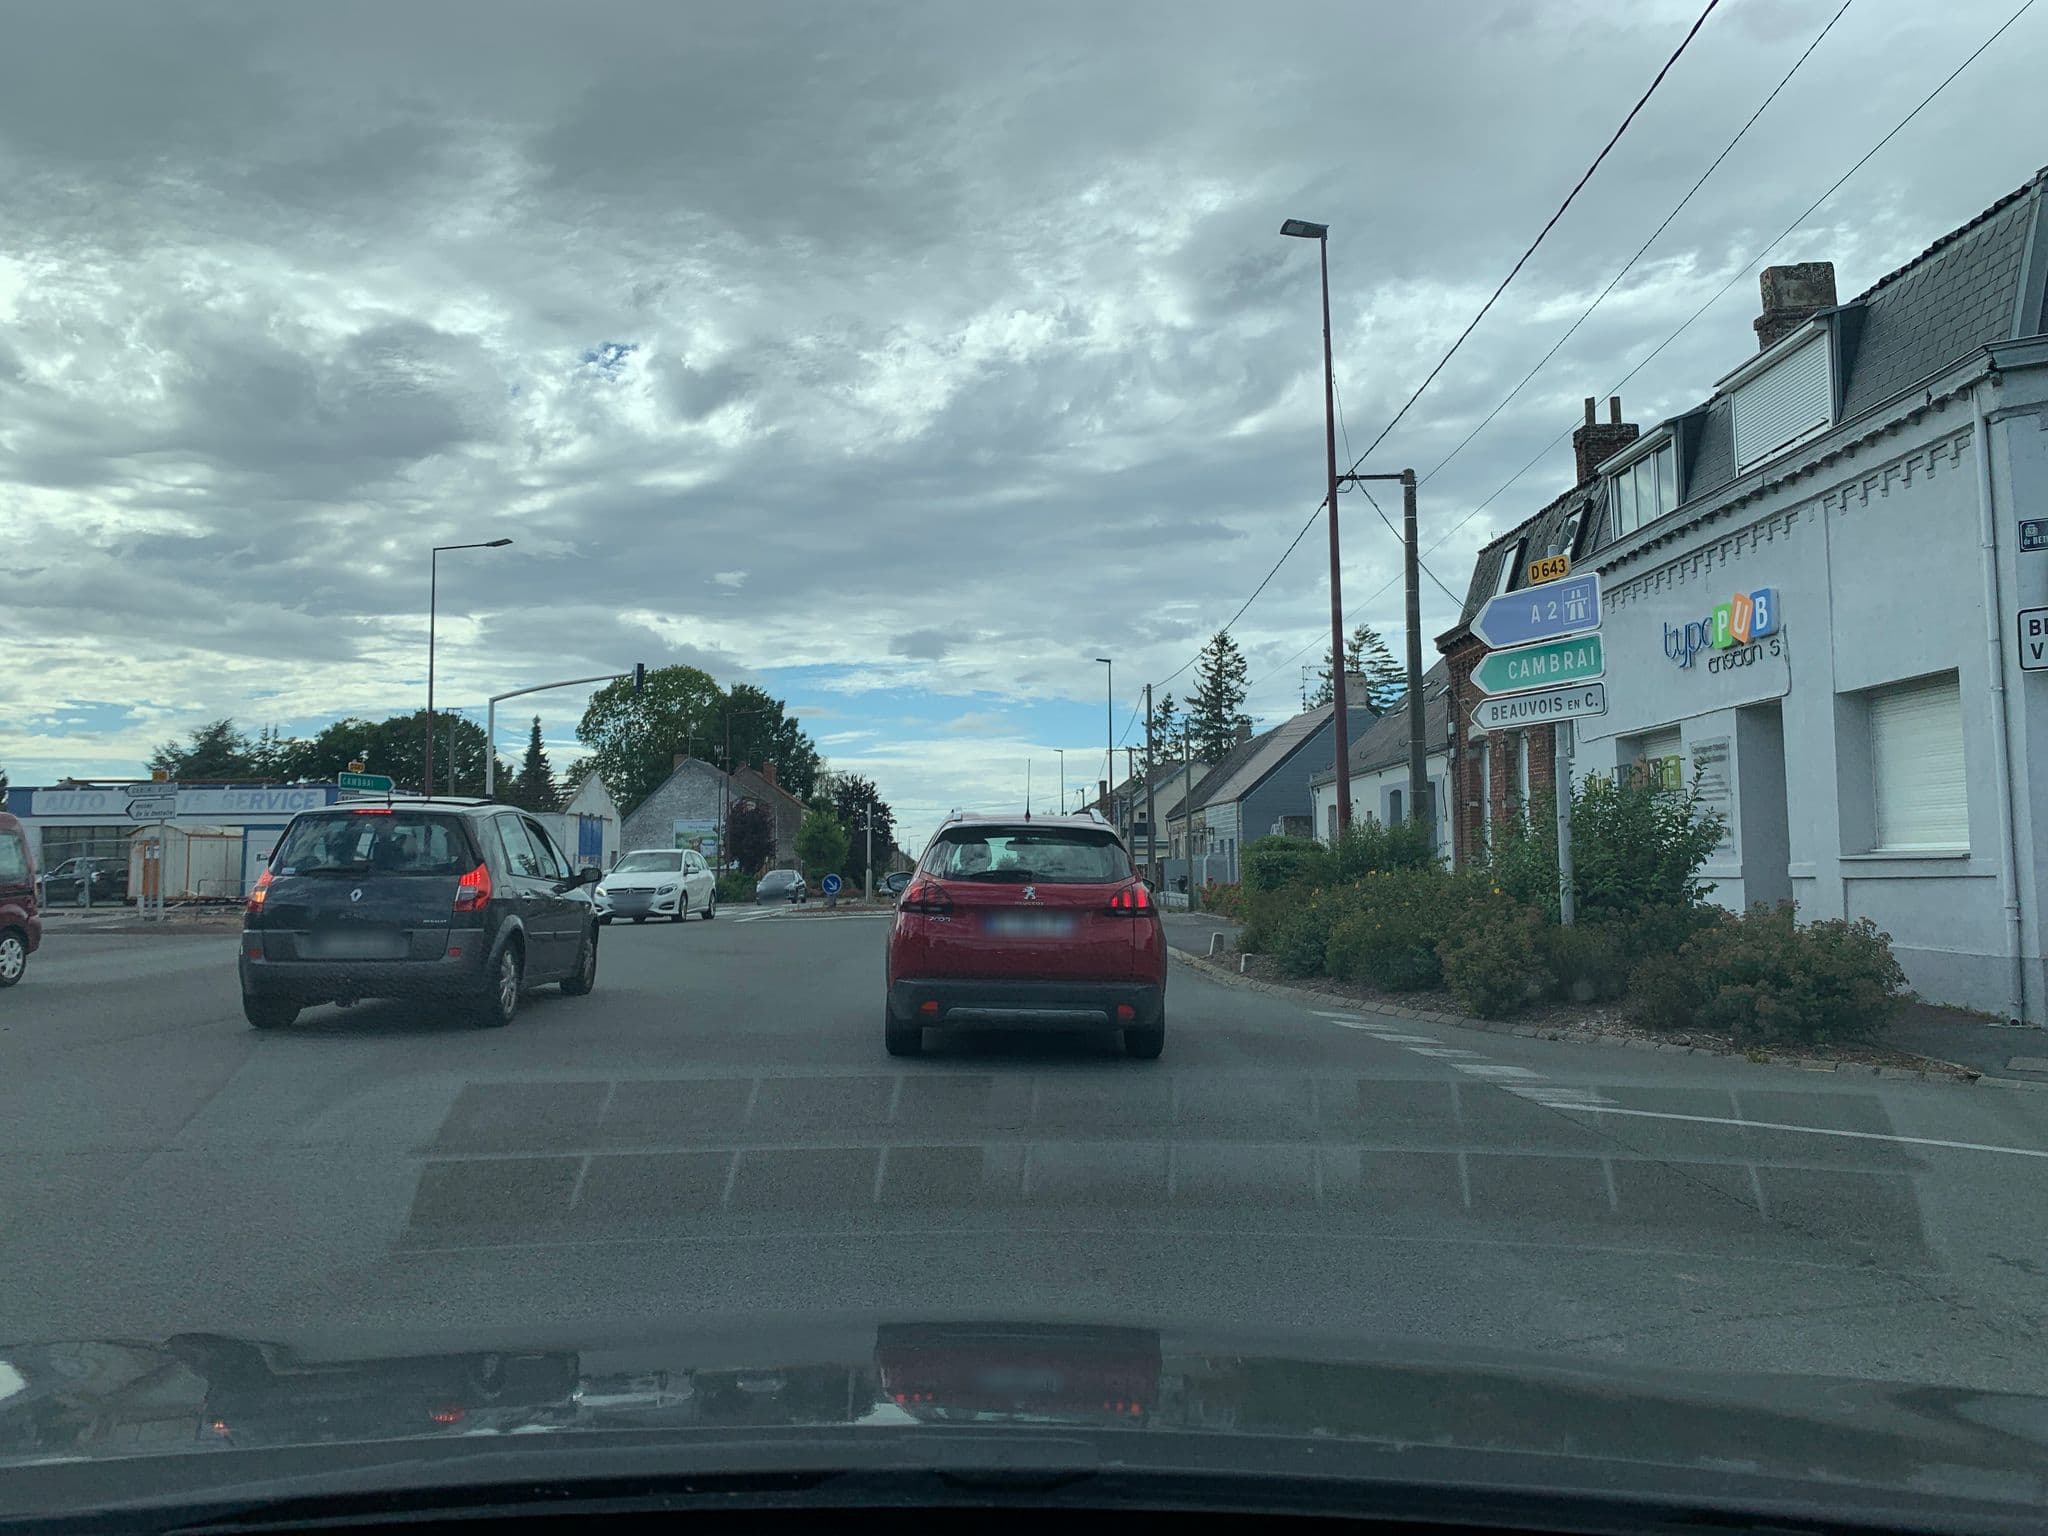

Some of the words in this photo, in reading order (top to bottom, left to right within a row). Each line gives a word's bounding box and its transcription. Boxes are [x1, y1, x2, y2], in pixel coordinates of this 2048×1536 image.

[1542, 559, 1567, 578] 643
[1531, 604, 1541, 625] A
[1547, 601, 1558, 620] 2
[1508, 646, 1596, 680] CAMBRAI
[1491, 697, 1563, 721] BEAUVOIS
[1567, 699, 1581, 711] EN
[1585, 692, 1599, 708] C.
[45, 792, 106, 811] AUTO
[223, 791, 318, 811] SERVICE
